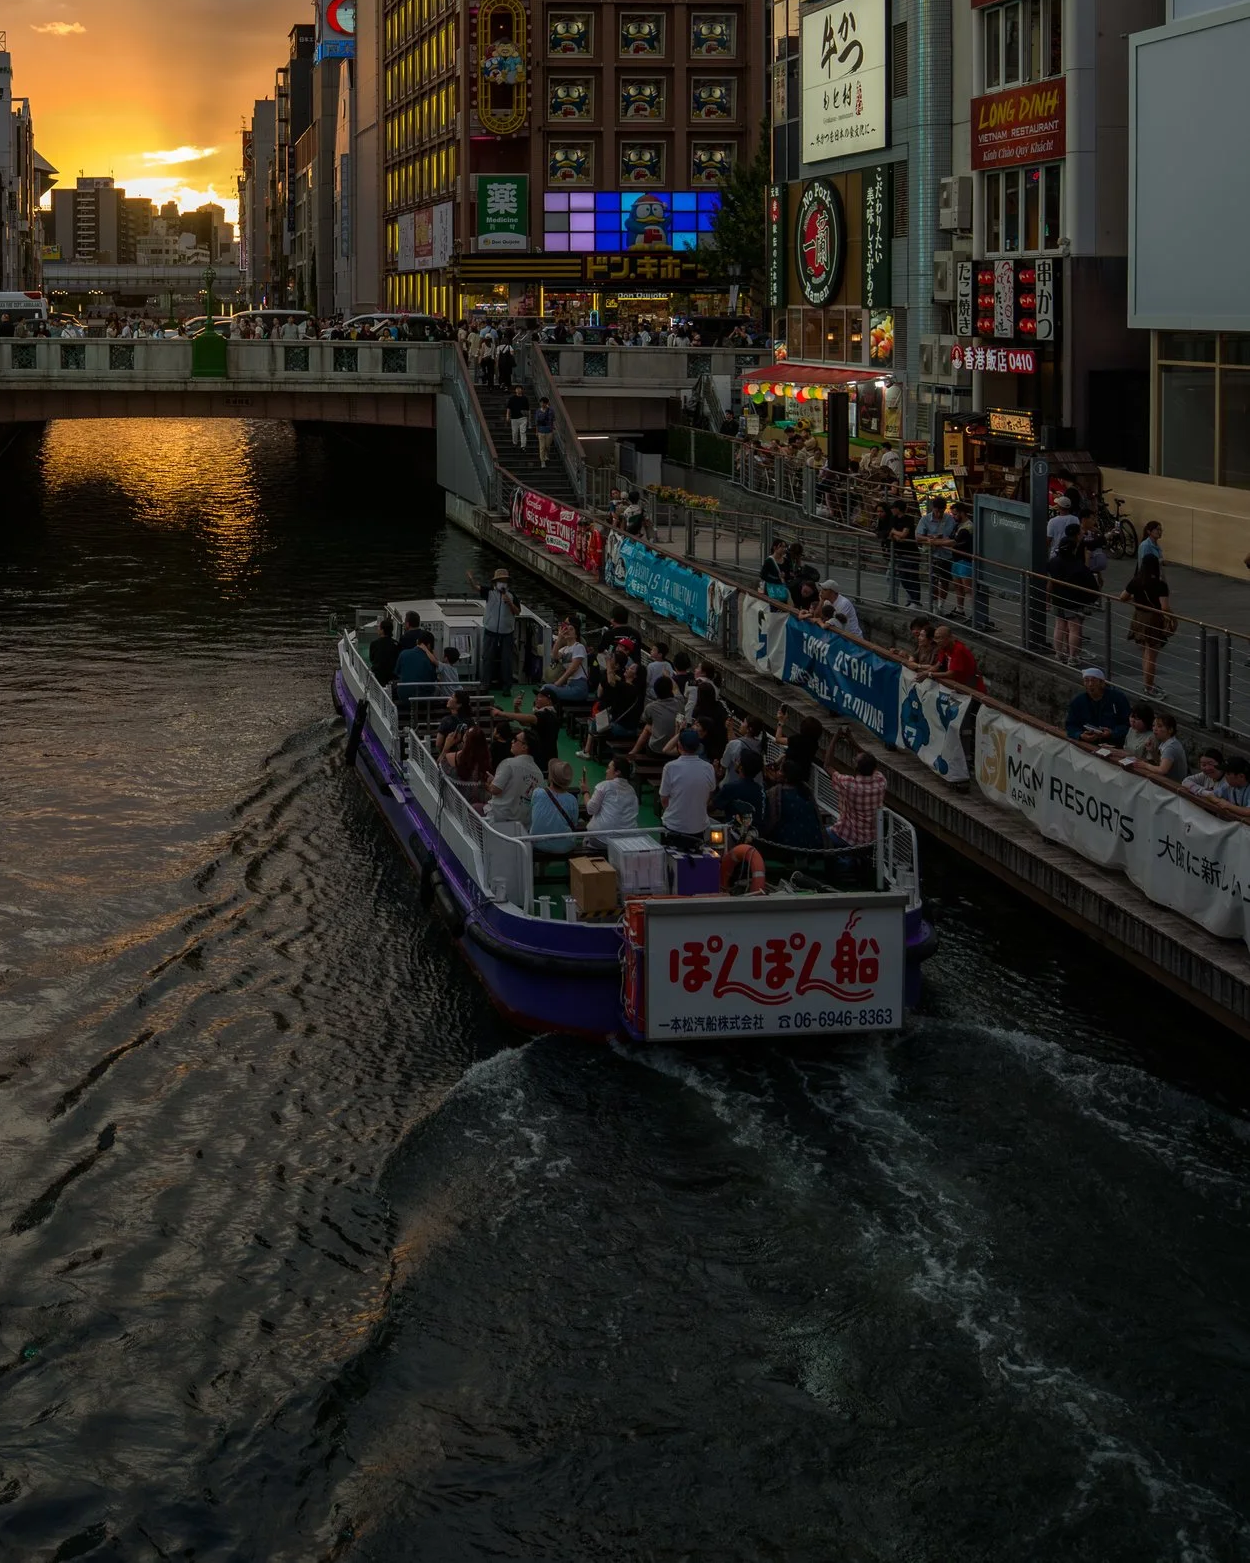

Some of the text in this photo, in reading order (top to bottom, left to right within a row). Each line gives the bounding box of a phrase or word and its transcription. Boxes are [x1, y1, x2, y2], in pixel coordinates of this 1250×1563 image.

[820, 11, 864, 79] 牛かつ
[979, 88, 1060, 131] LONG DINH
[978, 120, 1059, 144] VIETNAM RESTAURANT
[486, 182, 518, 215] 薬
[802, 182, 832, 211] No Pork
[804, 281, 830, 304] Ramen
[958, 263, 971, 335] たこ焼き
[1037, 260, 1053, 339] 串かつ
[963, 345, 1034, 373] 香港飯店 0410
[1155, 835, 1250, 904] 大阪に新しい
[669, 930, 881, 1006] ぽんぽん船
[658, 1007, 893, 1033] 一本松汽船株式会社 06-6946-8363
